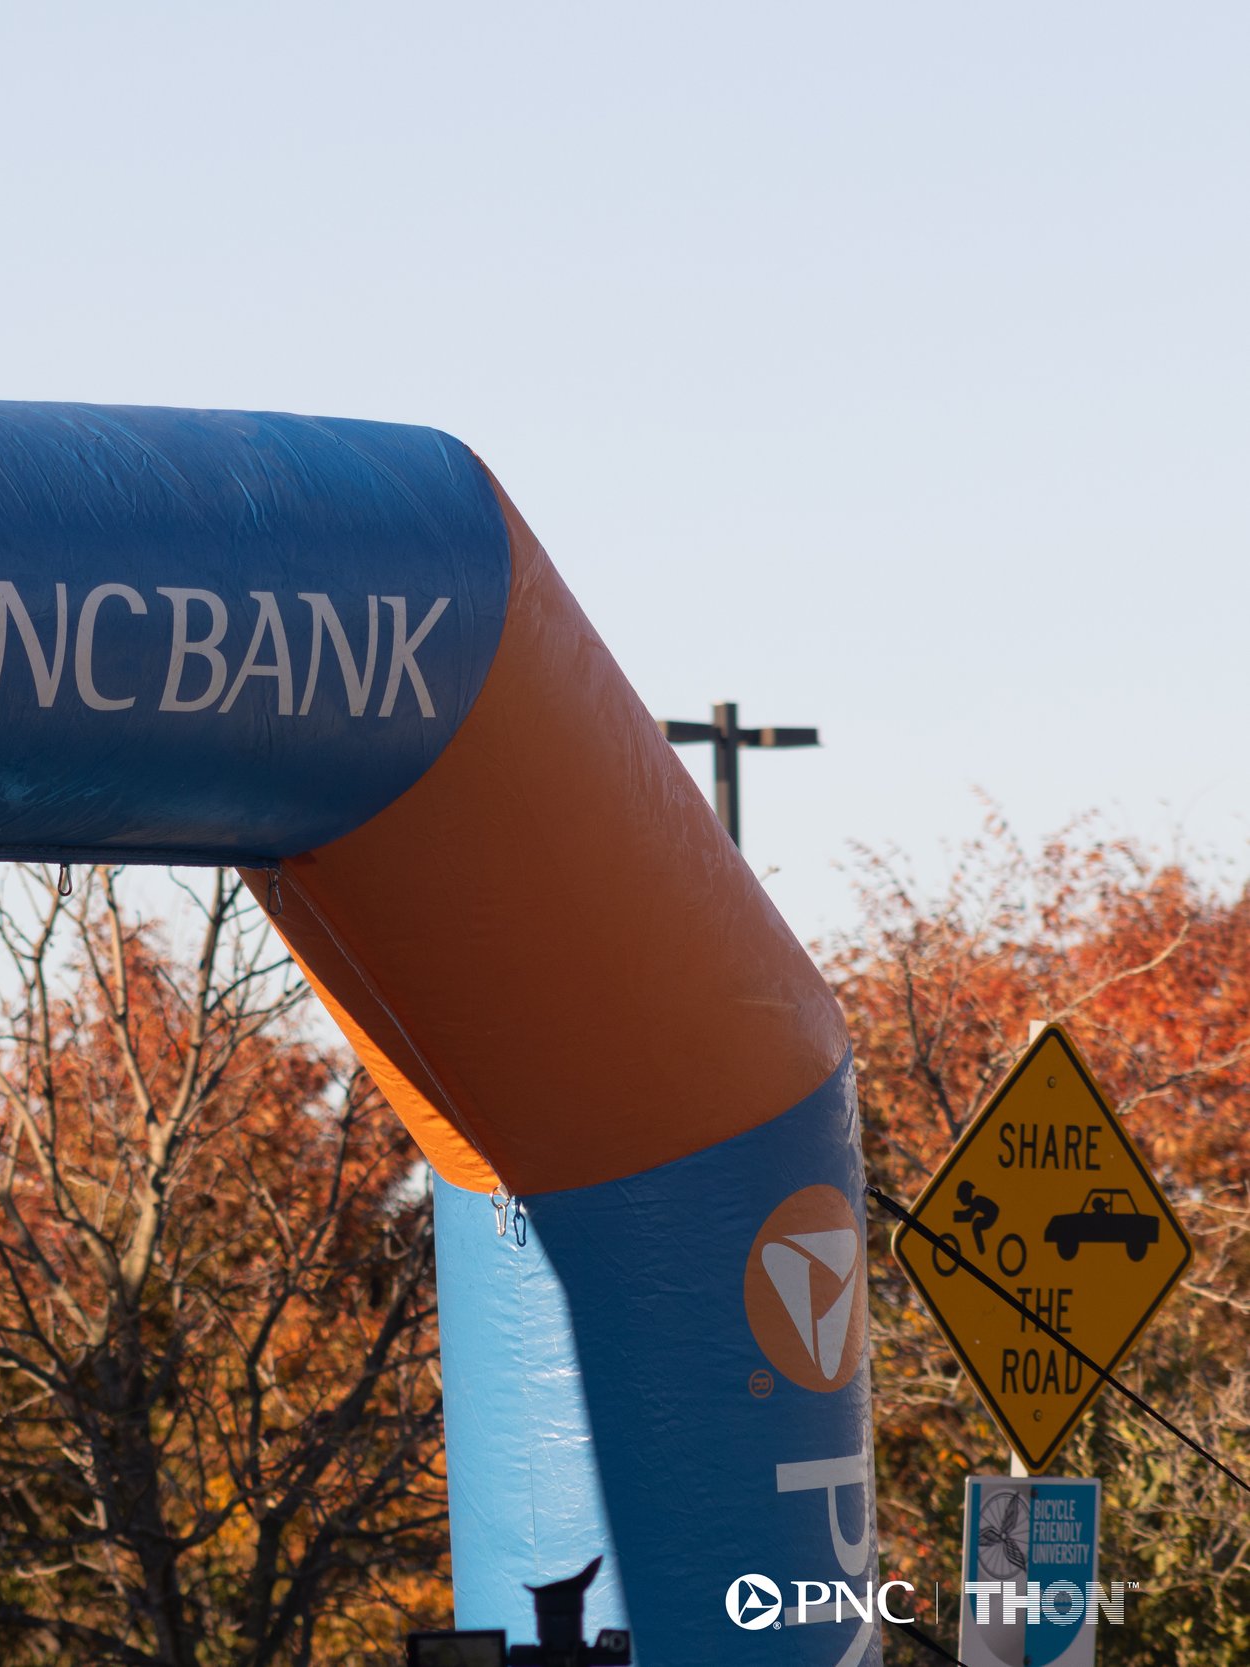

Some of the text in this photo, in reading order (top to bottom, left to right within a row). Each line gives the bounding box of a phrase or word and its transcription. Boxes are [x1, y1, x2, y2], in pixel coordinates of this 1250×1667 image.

[998, 1122, 1102, 1170] SHARE
[1017, 1288, 1073, 1334] THE
[1001, 1348, 1083, 1395] ROAD
[1034, 1499, 1076, 1521] BICYCLE
[1033, 1522, 1083, 1543] FRIENDLY
[1032, 1544, 1090, 1565] UNIVERSITY
